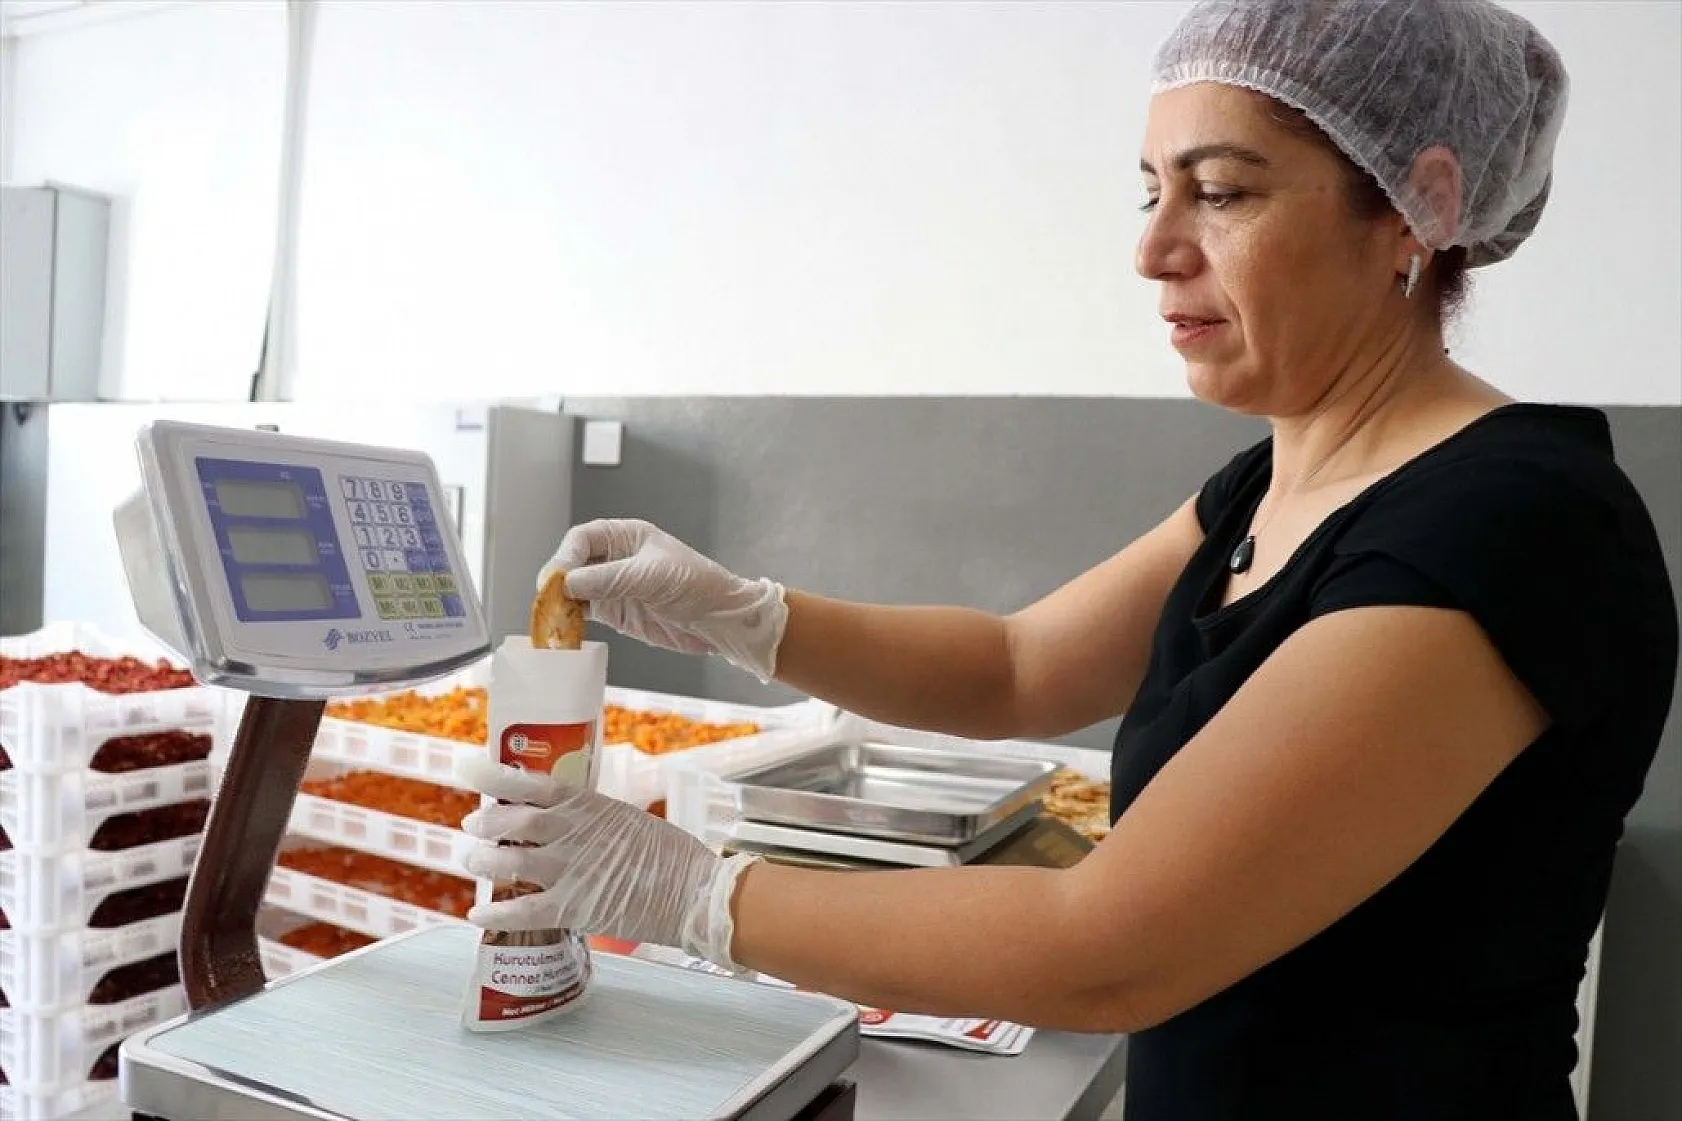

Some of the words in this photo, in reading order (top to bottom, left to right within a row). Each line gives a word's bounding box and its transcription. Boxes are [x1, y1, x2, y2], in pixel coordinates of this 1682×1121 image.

[344, 479, 357, 498] 7
[369, 481, 382, 499] 8
[392, 483, 403, 500] 9
[354, 502, 366, 519] 4
[376, 503, 388, 521] 5
[398, 504, 410, 523] 6
[360, 527, 371, 545] 1
[383, 528, 396, 545] 2
[404, 528, 418, 546] 3
[367, 551, 380, 568] 0
[347, 630, 393, 643] BOZYEL
